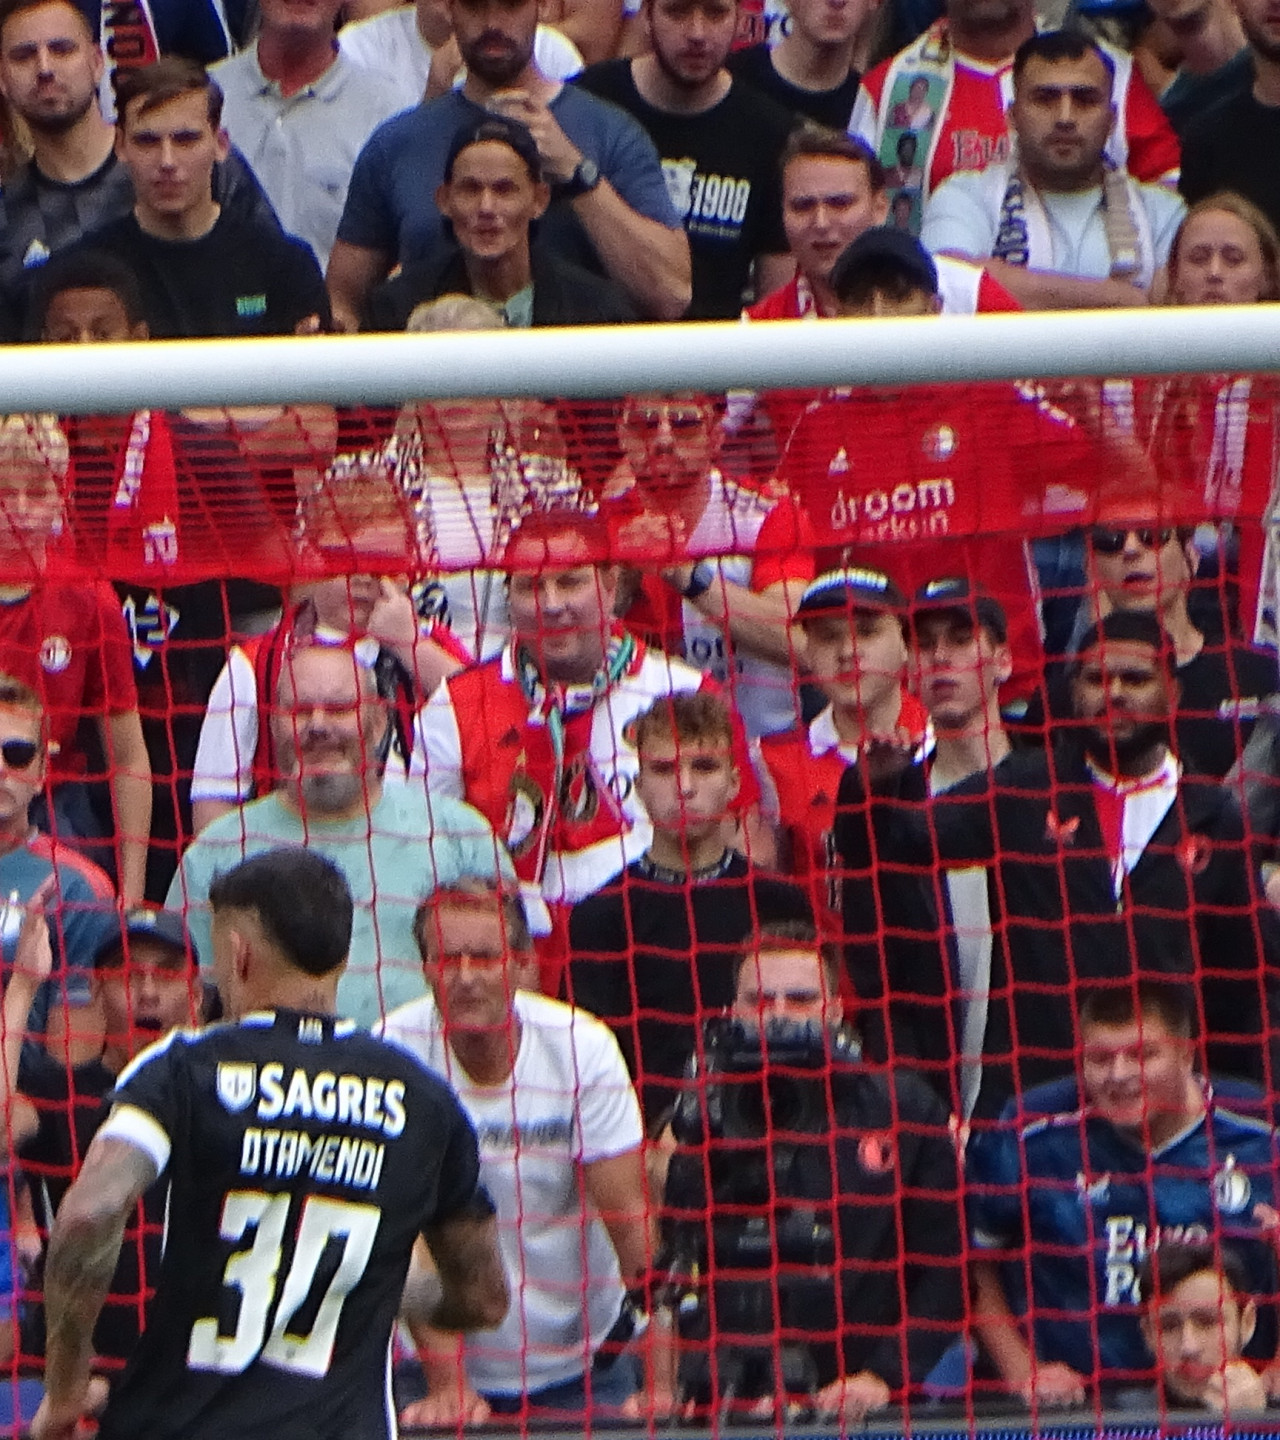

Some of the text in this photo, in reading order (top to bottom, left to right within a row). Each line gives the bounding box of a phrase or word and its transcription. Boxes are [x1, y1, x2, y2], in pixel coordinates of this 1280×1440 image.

[692, 173, 752, 223] 1908
[831, 477, 955, 530] droom
[257, 1062, 407, 1140] SAGRES
[240, 1129, 385, 1191] OTAMENDI
[187, 1190, 381, 1378] 30
